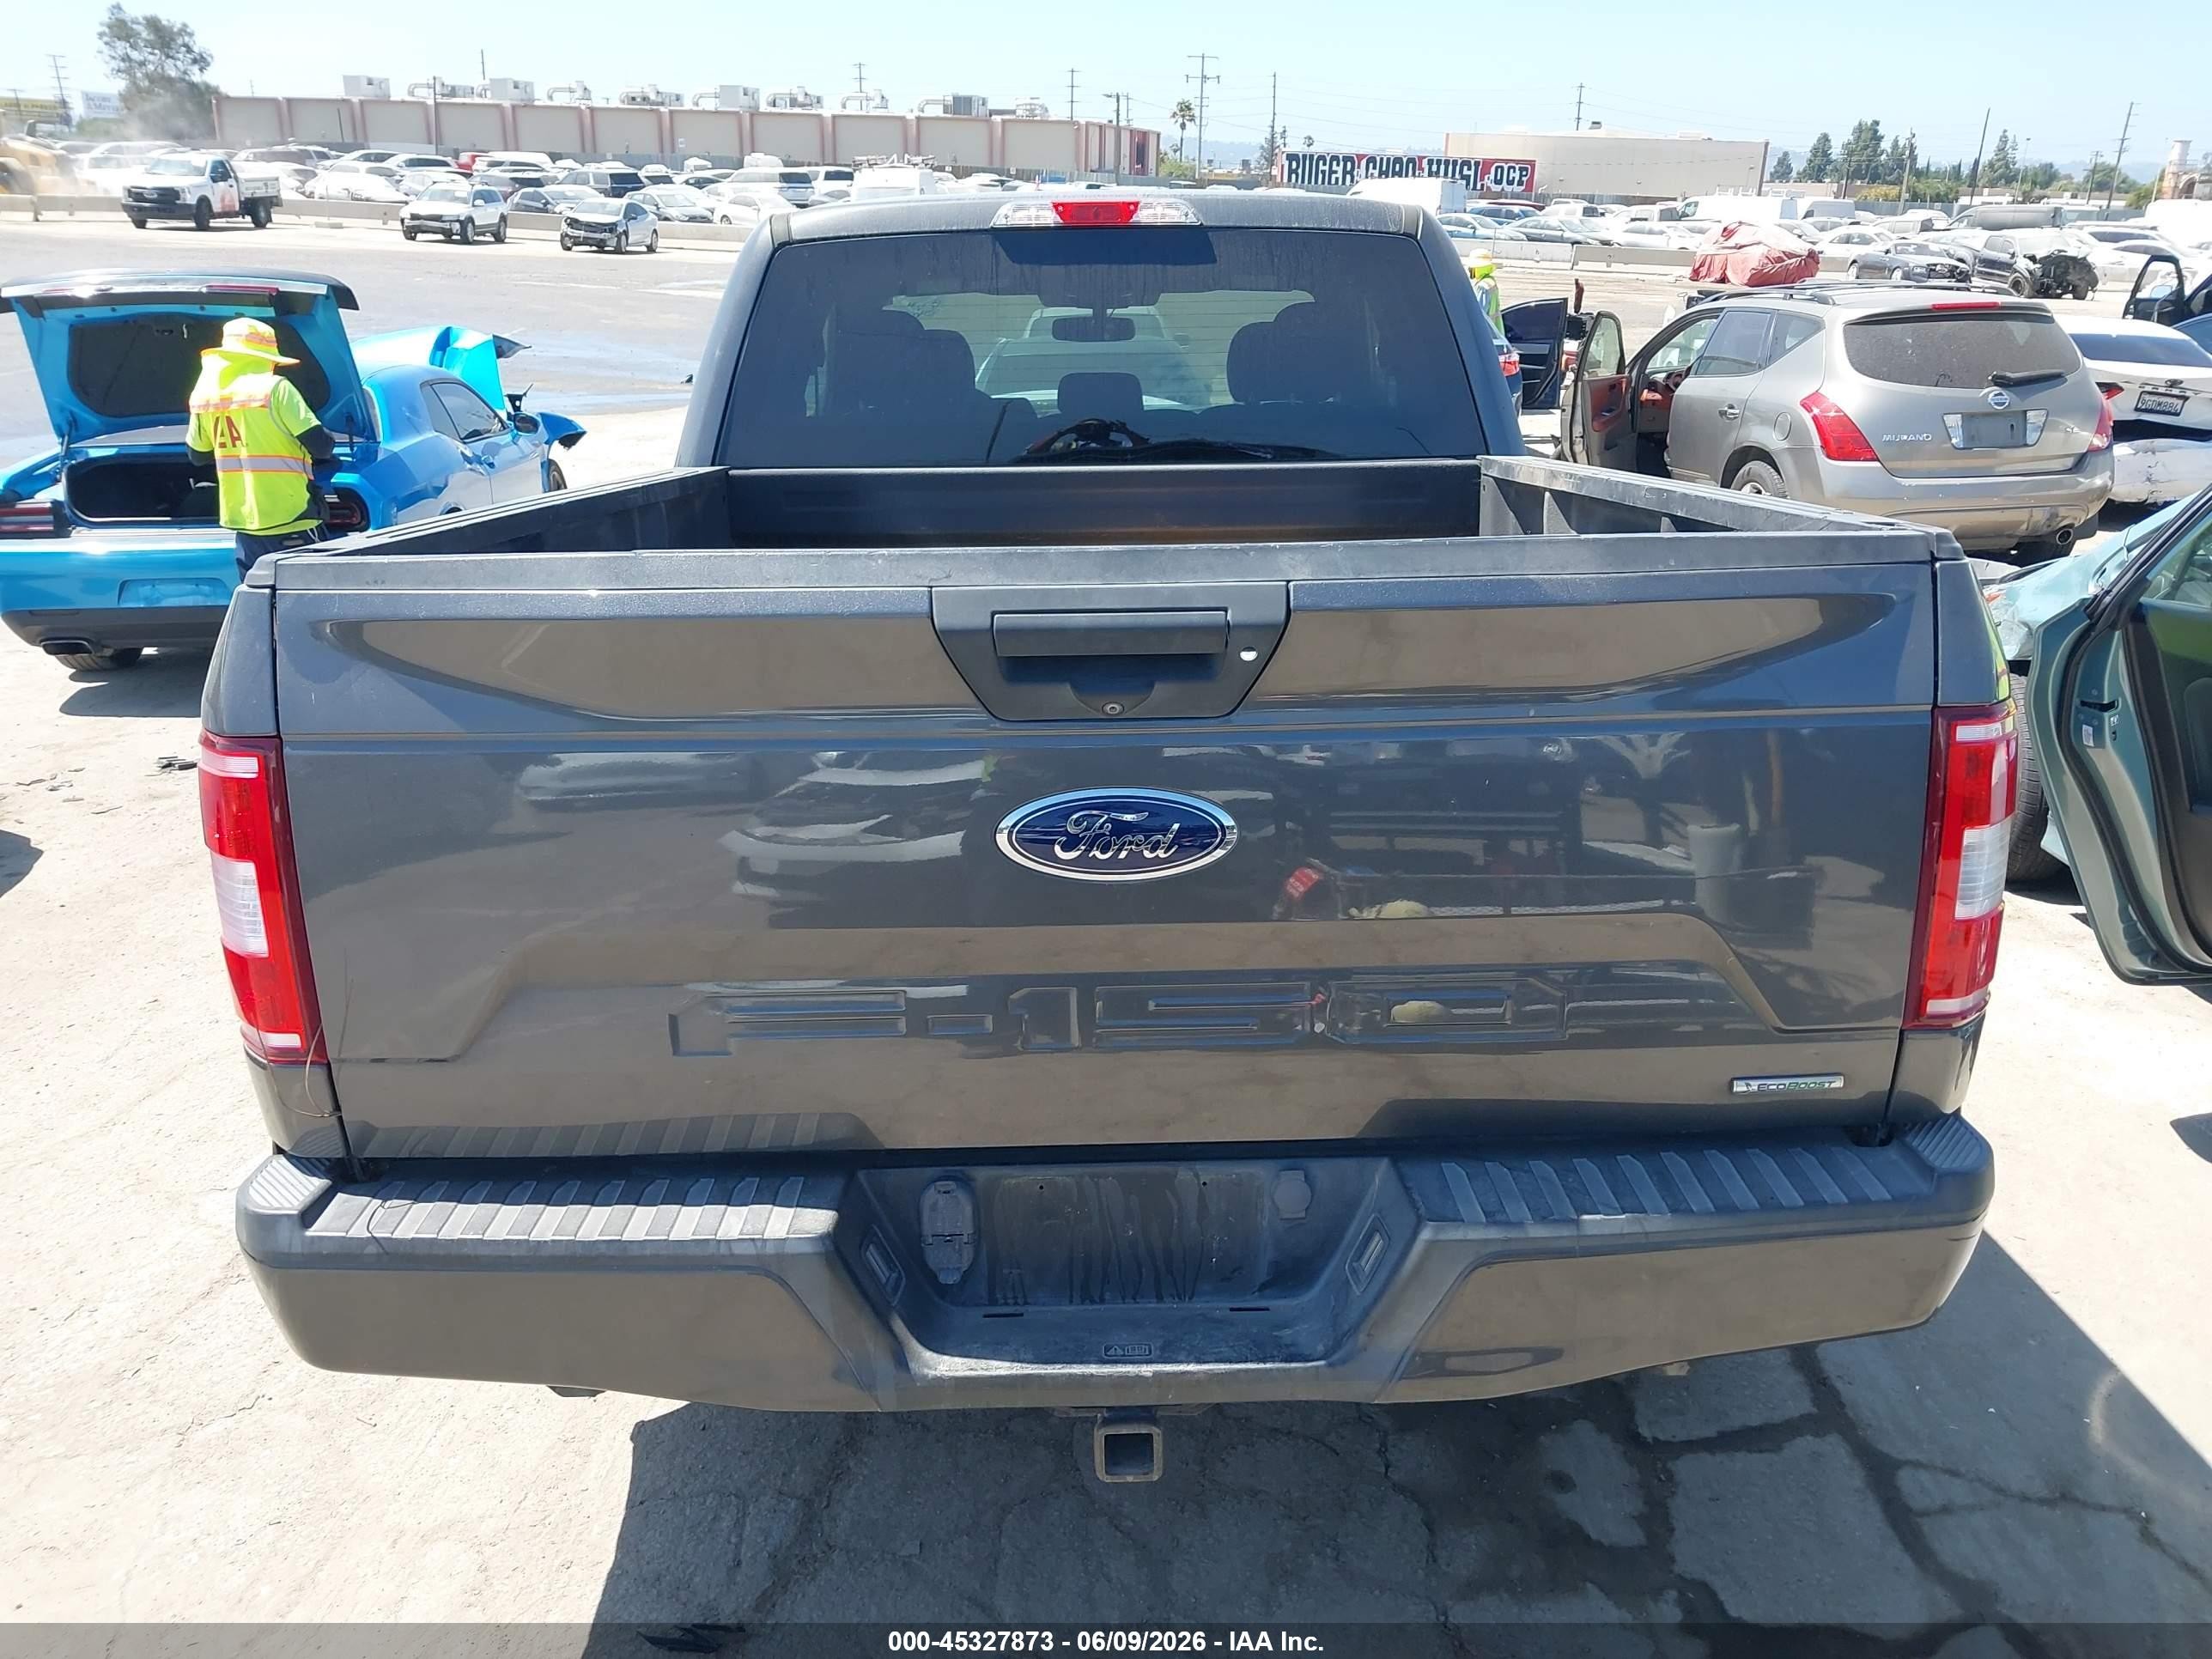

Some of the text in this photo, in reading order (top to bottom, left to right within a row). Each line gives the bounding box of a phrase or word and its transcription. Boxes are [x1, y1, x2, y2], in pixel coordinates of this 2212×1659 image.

[1494, 165, 1528, 186] OCP
[1881, 433, 1932, 441] MURANO
[1053, 810, 1182, 860] Ford
[670, 981, 1566, 1054] F-150
